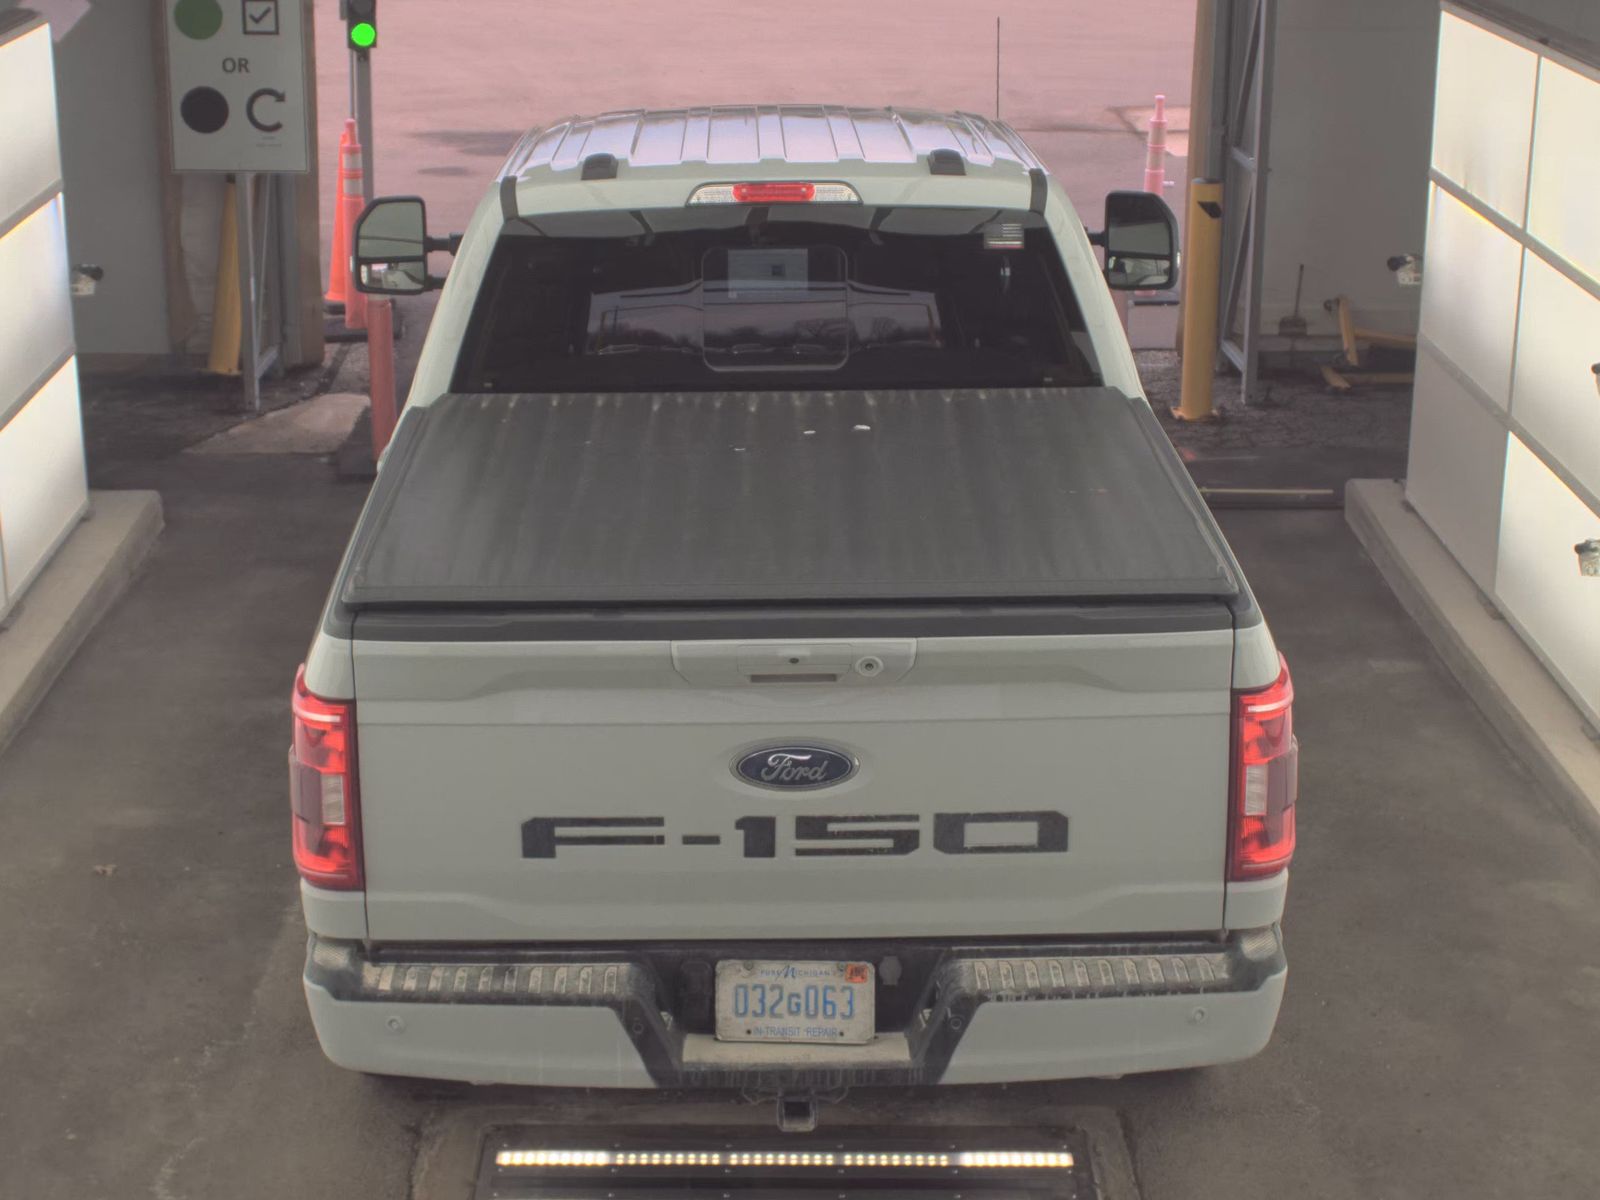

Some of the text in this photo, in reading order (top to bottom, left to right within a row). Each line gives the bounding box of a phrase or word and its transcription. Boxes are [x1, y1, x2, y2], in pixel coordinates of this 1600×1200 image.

[222, 57, 249, 73] OR
[761, 753, 828, 781] Ford
[521, 810, 1069, 859] F-150
[734, 984, 855, 1019] 032G063
[753, 1026, 838, 1038] IN-TRANSIT REPAIR
